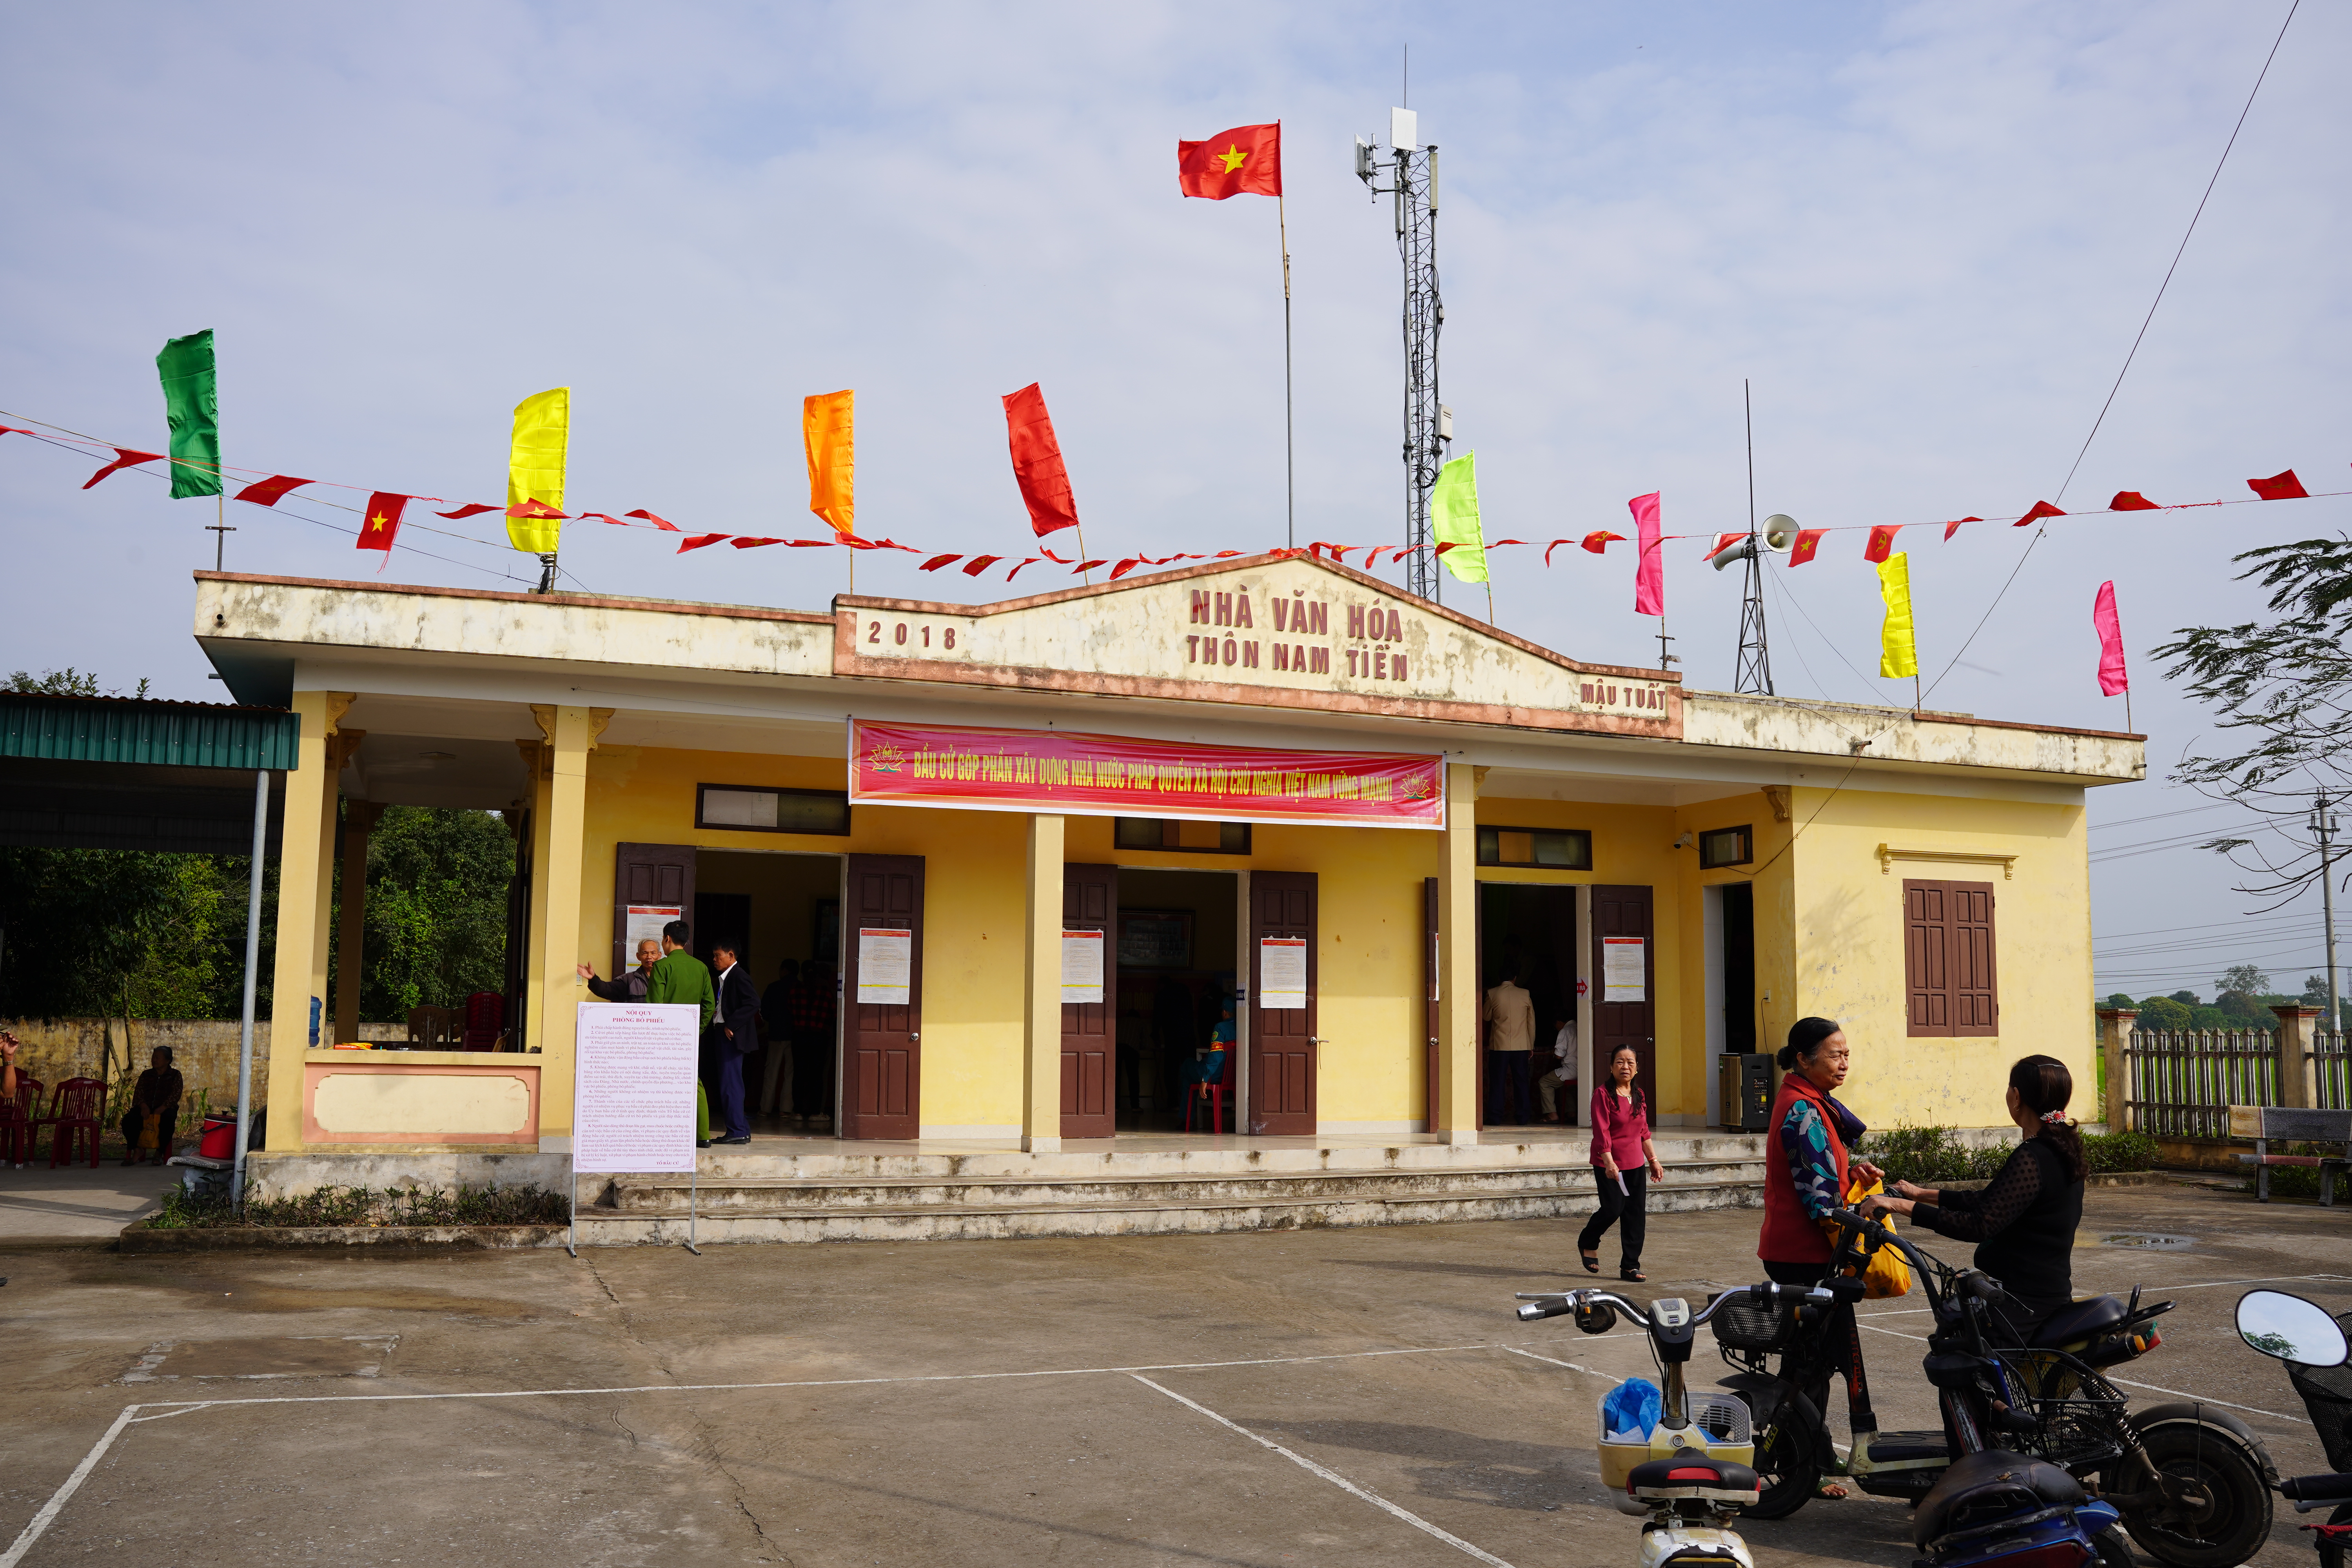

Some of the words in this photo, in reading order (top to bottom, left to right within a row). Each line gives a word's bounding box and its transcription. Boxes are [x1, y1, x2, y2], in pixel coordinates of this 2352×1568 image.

[1191, 584, 1253, 628] NHÀ
[1272, 590, 1327, 635] VĂN
[1348, 597, 1403, 642] HÓA
[868, 621, 955, 650] 2018
[1187, 631, 1259, 668] THÔN
[1272, 642, 1329, 674] NAM
[1581, 678, 1616, 709] MẬU
[1624, 682, 1665, 710] TUẤT
[914, 742, 936, 779] BẦU
[940, 744, 955, 780] CỬ
[957, 749, 979, 781] GÓP
[983, 746, 1012, 782] PHẦN
[1015, 751, 1036, 784] XÂY
[1039, 756, 1069, 791] DỰNG
[1071, 755, 1093, 787] NHÀ
[1096, 757, 1125, 788] NƯỚC
[1128, 759, 1156, 790] PHÁP
[1158, 758, 1192, 794] QUYỀN
[1194, 763, 1208, 793] XÃ
[1210, 763, 1227, 799] HỘI
[1230, 762, 1250, 795] CHỦ
[1252, 767, 1282, 796] NGHĨA
[1285, 767, 1306, 803] VIỆT
[1307, 773, 1330, 799] NAM
[1332, 770, 1358, 800] VỮNG
[1361, 776, 1393, 806] MẠNH!
